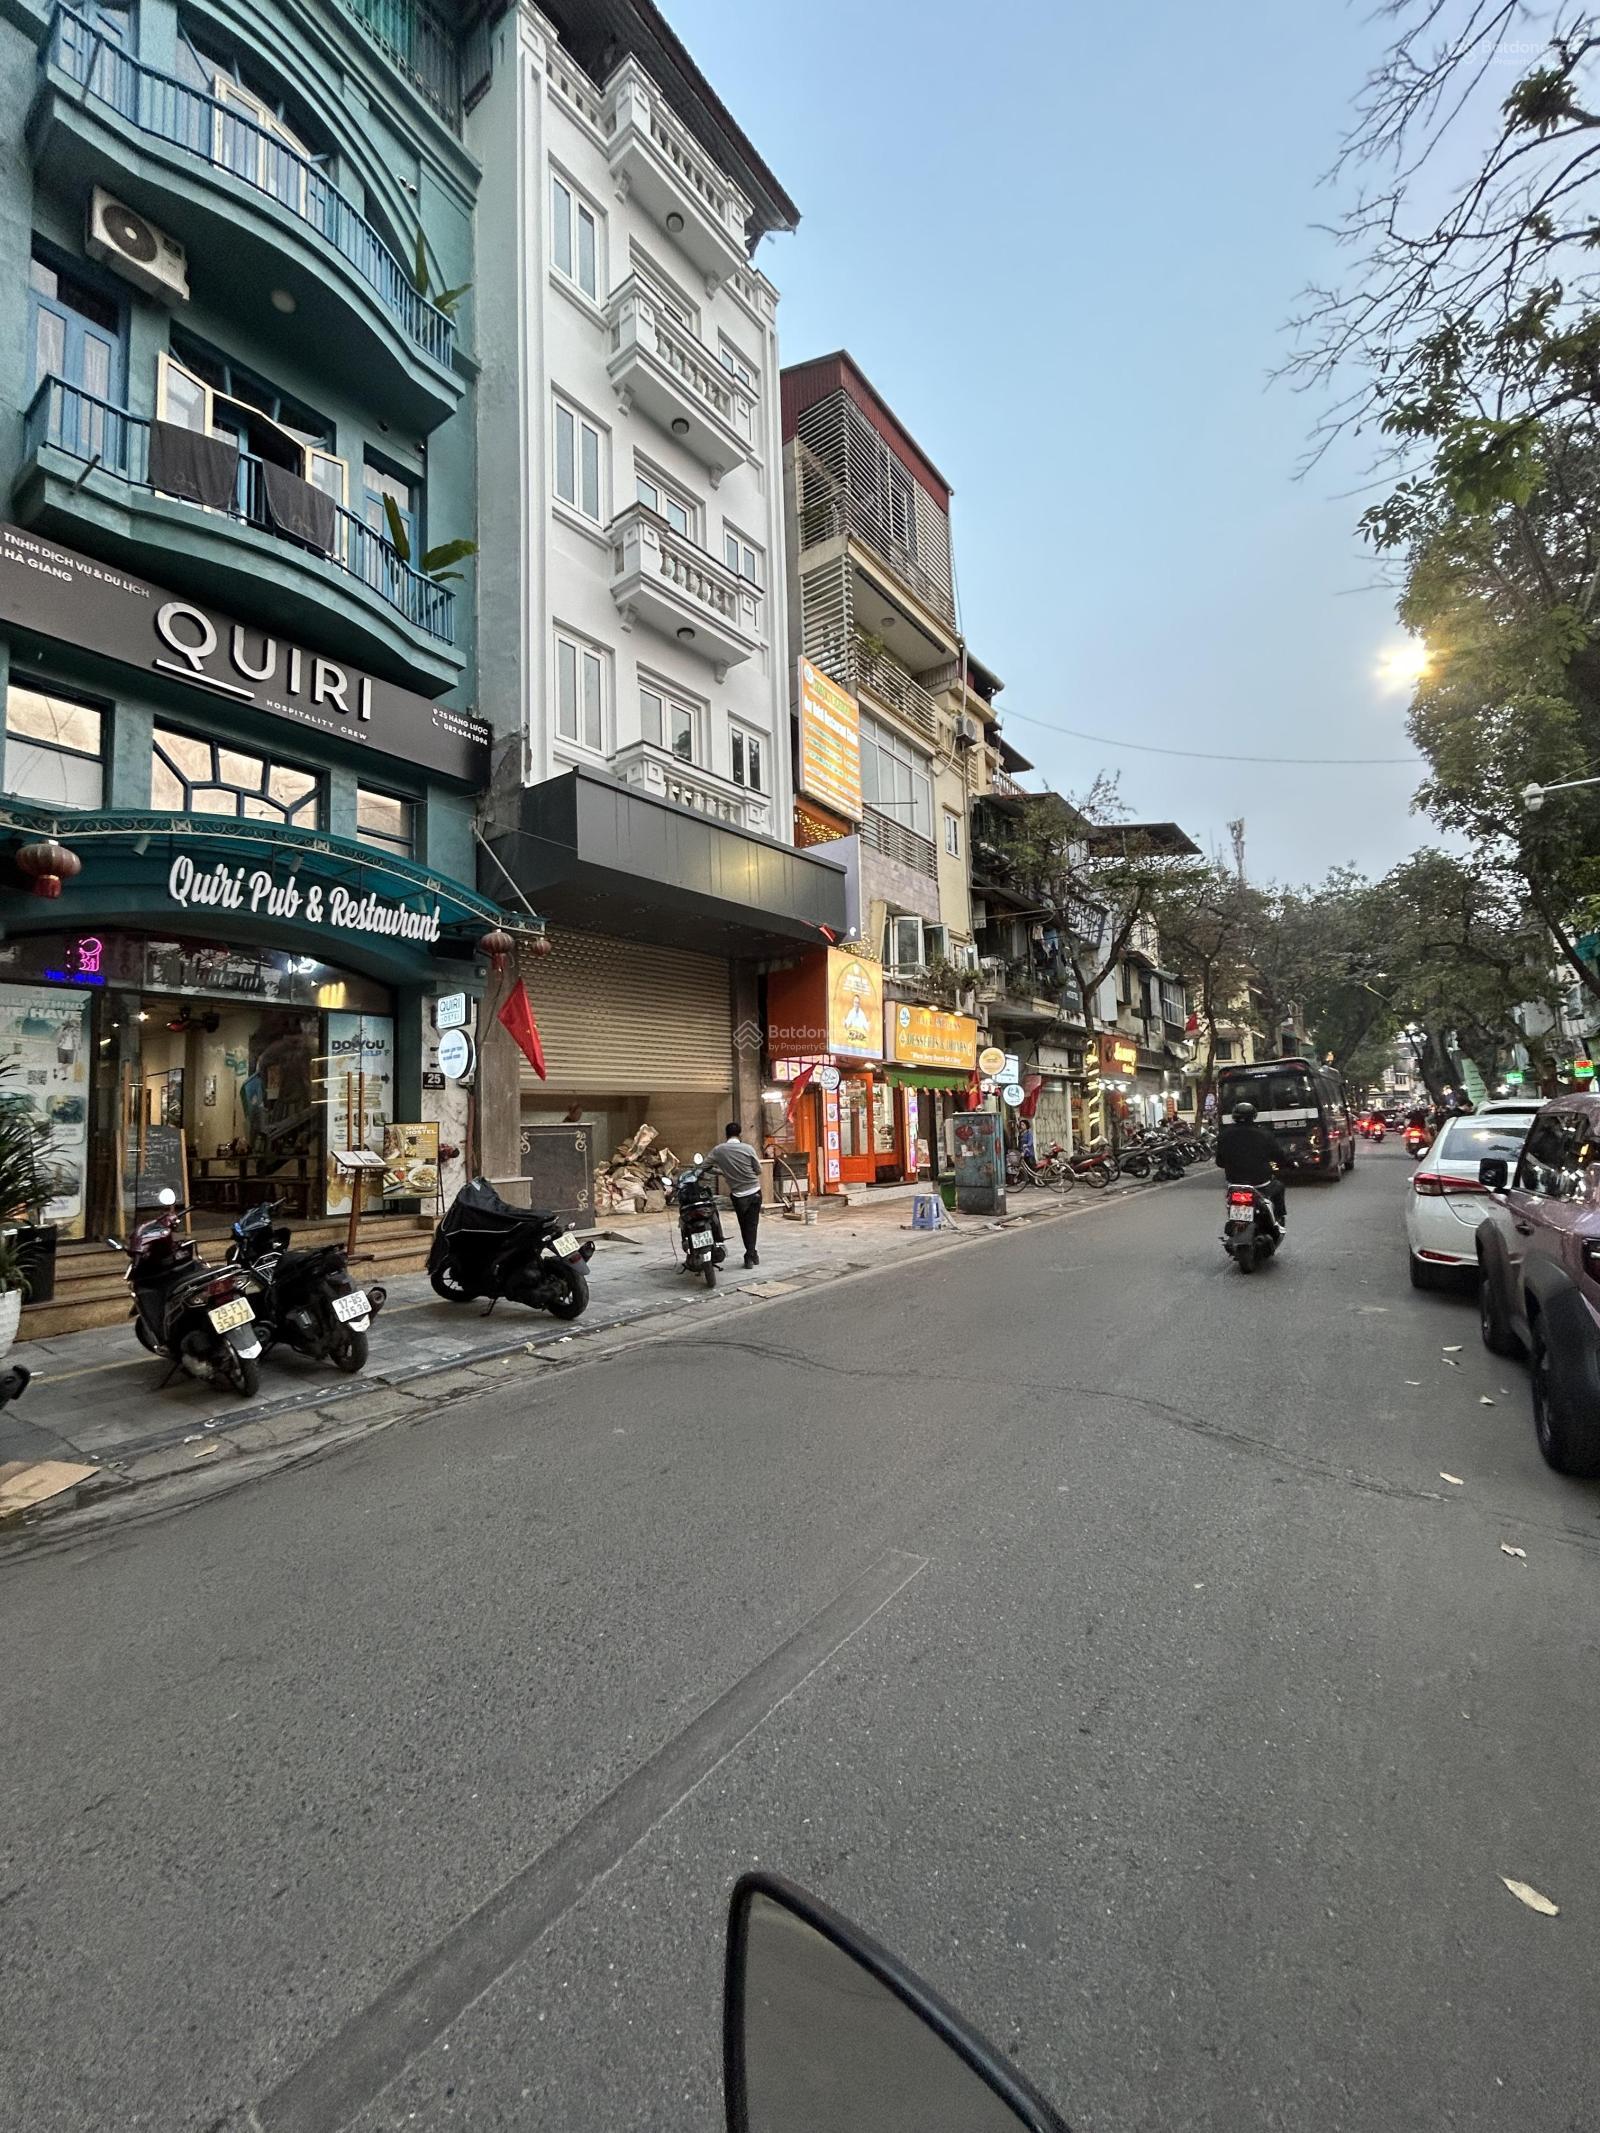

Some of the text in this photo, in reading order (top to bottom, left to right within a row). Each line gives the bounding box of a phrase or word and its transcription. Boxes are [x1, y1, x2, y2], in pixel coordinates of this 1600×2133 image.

[4, 532, 39, 553] TNHH
[41, 549, 73, 568] DỊCH
[75, 561, 92, 577] VỤ
[93, 569, 102, 579] &
[104, 572, 121, 586] DU
[123, 581, 150, 598] LỊCH
[4, 550, 25, 564] HÀ
[27, 558, 73, 582] GIANG
[157, 602, 372, 720] QUIRI
[266, 699, 368, 740] HOSPITALITY CREW
[438, 710, 448, 719] 25
[449, 714, 469, 727] HÀNG
[168, 855, 441, 942] Quiri Pub & Restaurant
[29, 1008, 82, 1020] HAVE
[440, 998, 461, 1012] QUIRI
[332, 1040, 352, 1050] DO
[427, 1074, 441, 1084] 25
